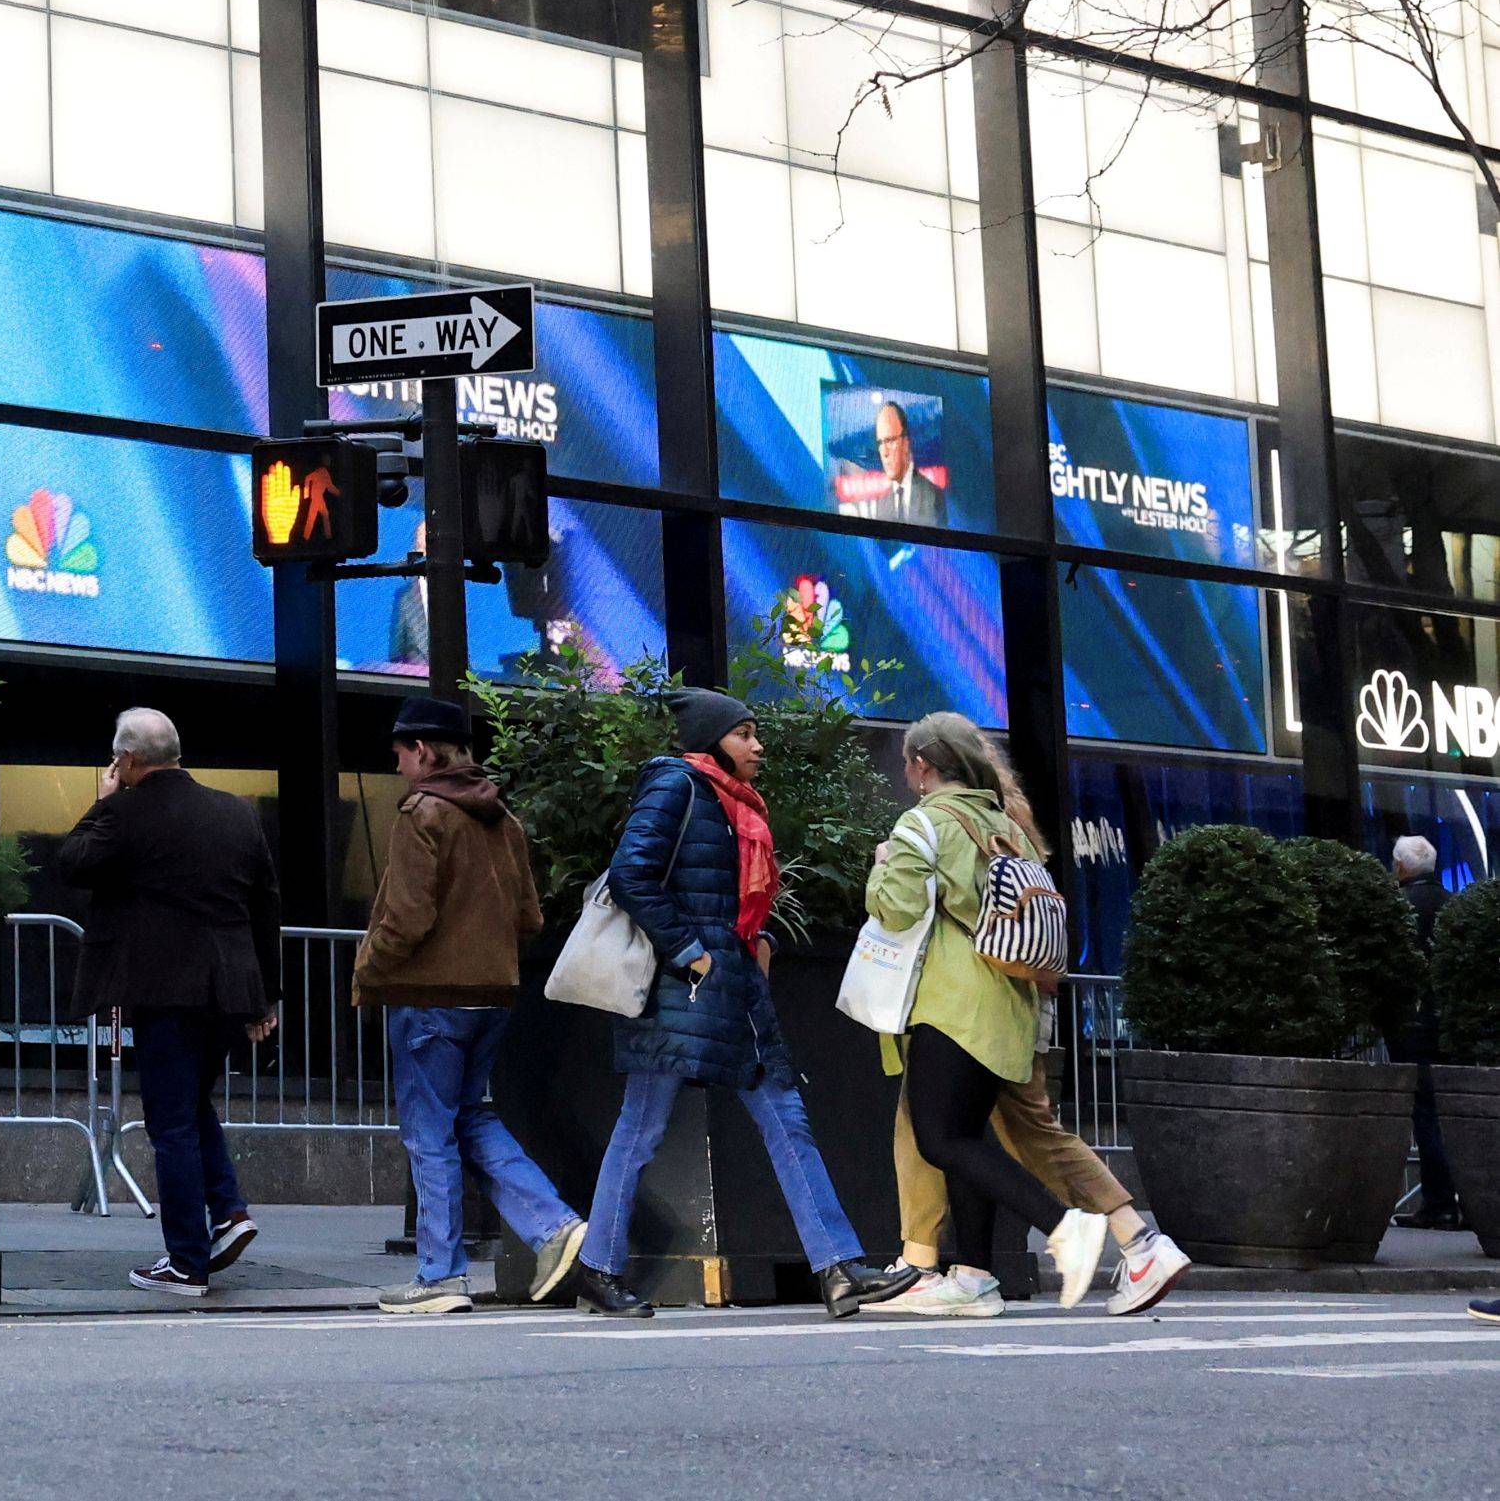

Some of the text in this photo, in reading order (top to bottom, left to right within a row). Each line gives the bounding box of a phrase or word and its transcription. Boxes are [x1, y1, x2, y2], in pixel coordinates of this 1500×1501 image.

[348, 316, 499, 359] ONE WAY
[457, 376, 559, 424] NEWS
[519, 419, 558, 442] HOLT
[1048, 443, 1067, 463] BC
[1049, 462, 1209, 517] GHTLY NEWS
[1133, 509, 1178, 530] LESTER
[1179, 515, 1208, 533] HOLT
[7, 567, 99, 597] NBC NEWS
[1432, 680, 1500, 758] NB
